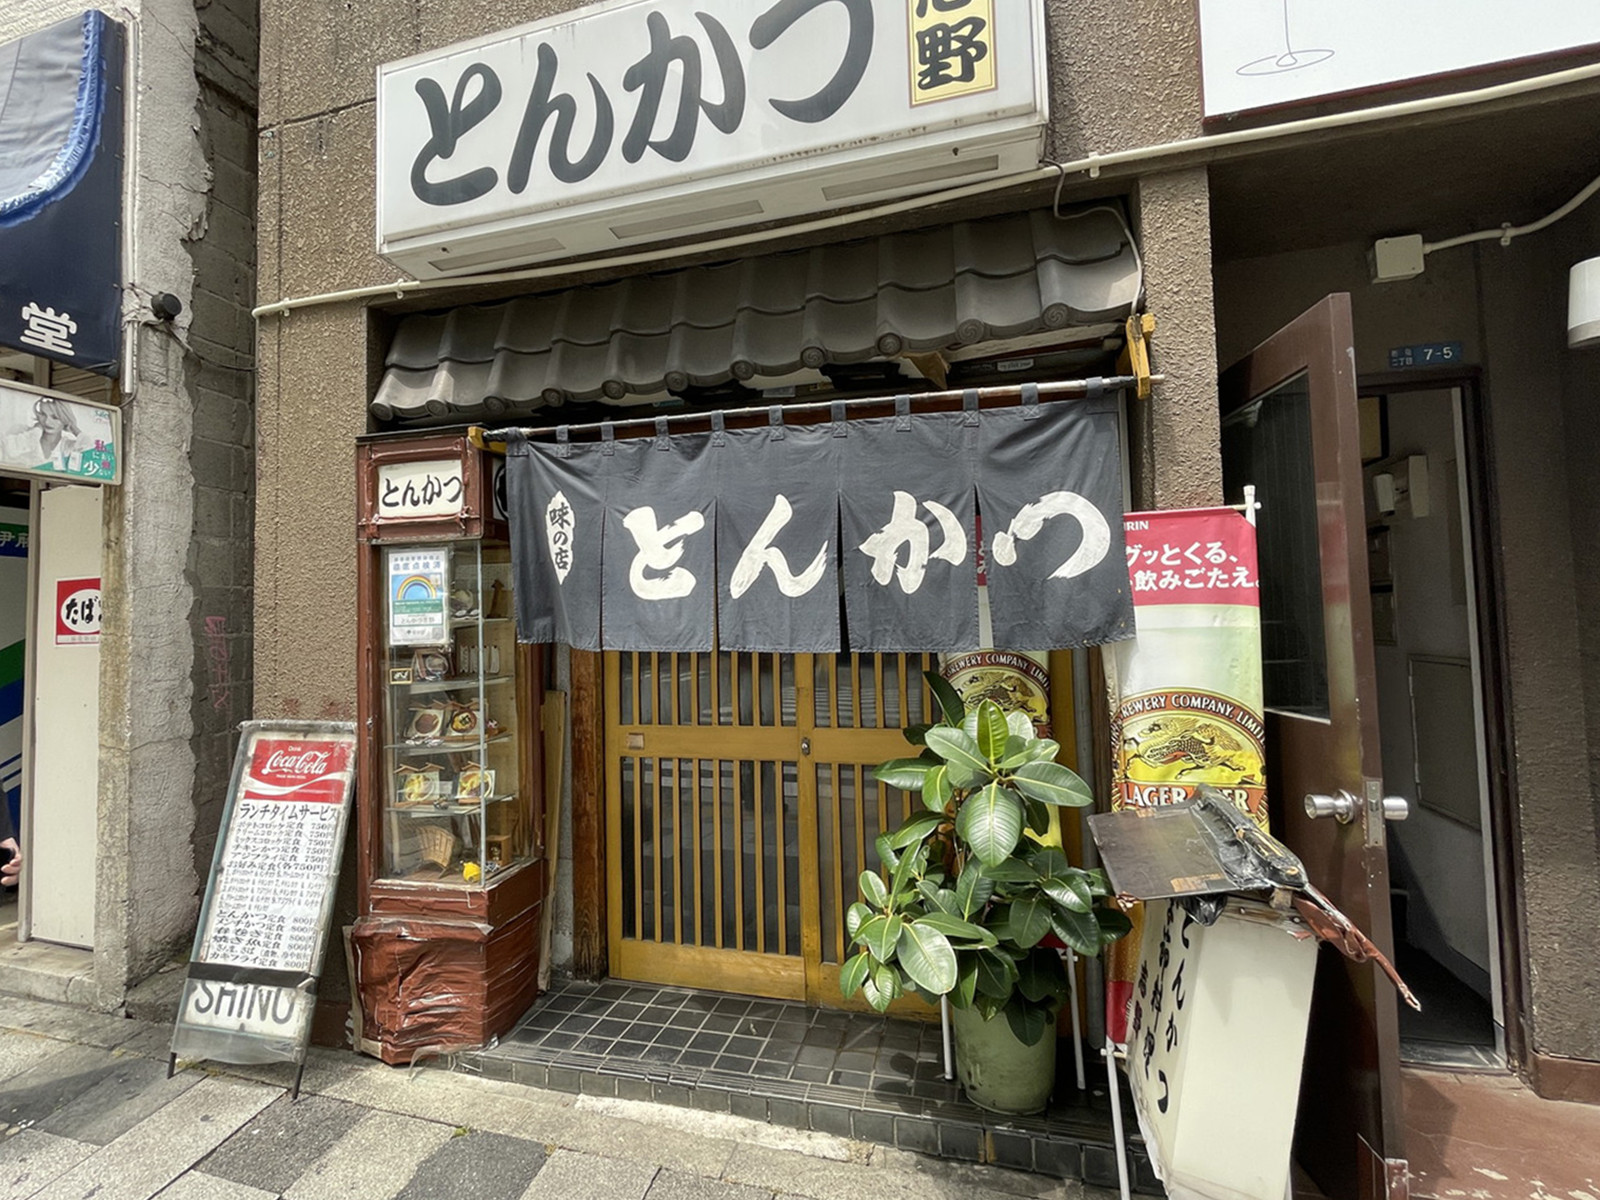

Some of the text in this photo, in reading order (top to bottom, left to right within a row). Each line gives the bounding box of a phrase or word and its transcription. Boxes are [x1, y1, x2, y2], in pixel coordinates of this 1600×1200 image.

[411, 0, 874, 206] とんかつ
[20, 302, 78, 356] 堂
[1423, 346, 1453, 361] 7-5
[381, 475, 463, 507] とんかつ
[549, 502, 572, 570] 味の店
[1124, 520, 1149, 531] RIN
[622, 490, 1112, 600] とんかつ
[1126, 541, 1238, 567] グッとくる、
[1130, 566, 1260, 592] 飲みごたえ。
[65, 595, 102, 625] たば
[1121, 695, 1166, 718] REWERY
[1123, 787, 1186, 807] LAGER
[240, 803, 338, 821] ランチタイムサービス
[217, 909, 286, 923] とんかつ定食
